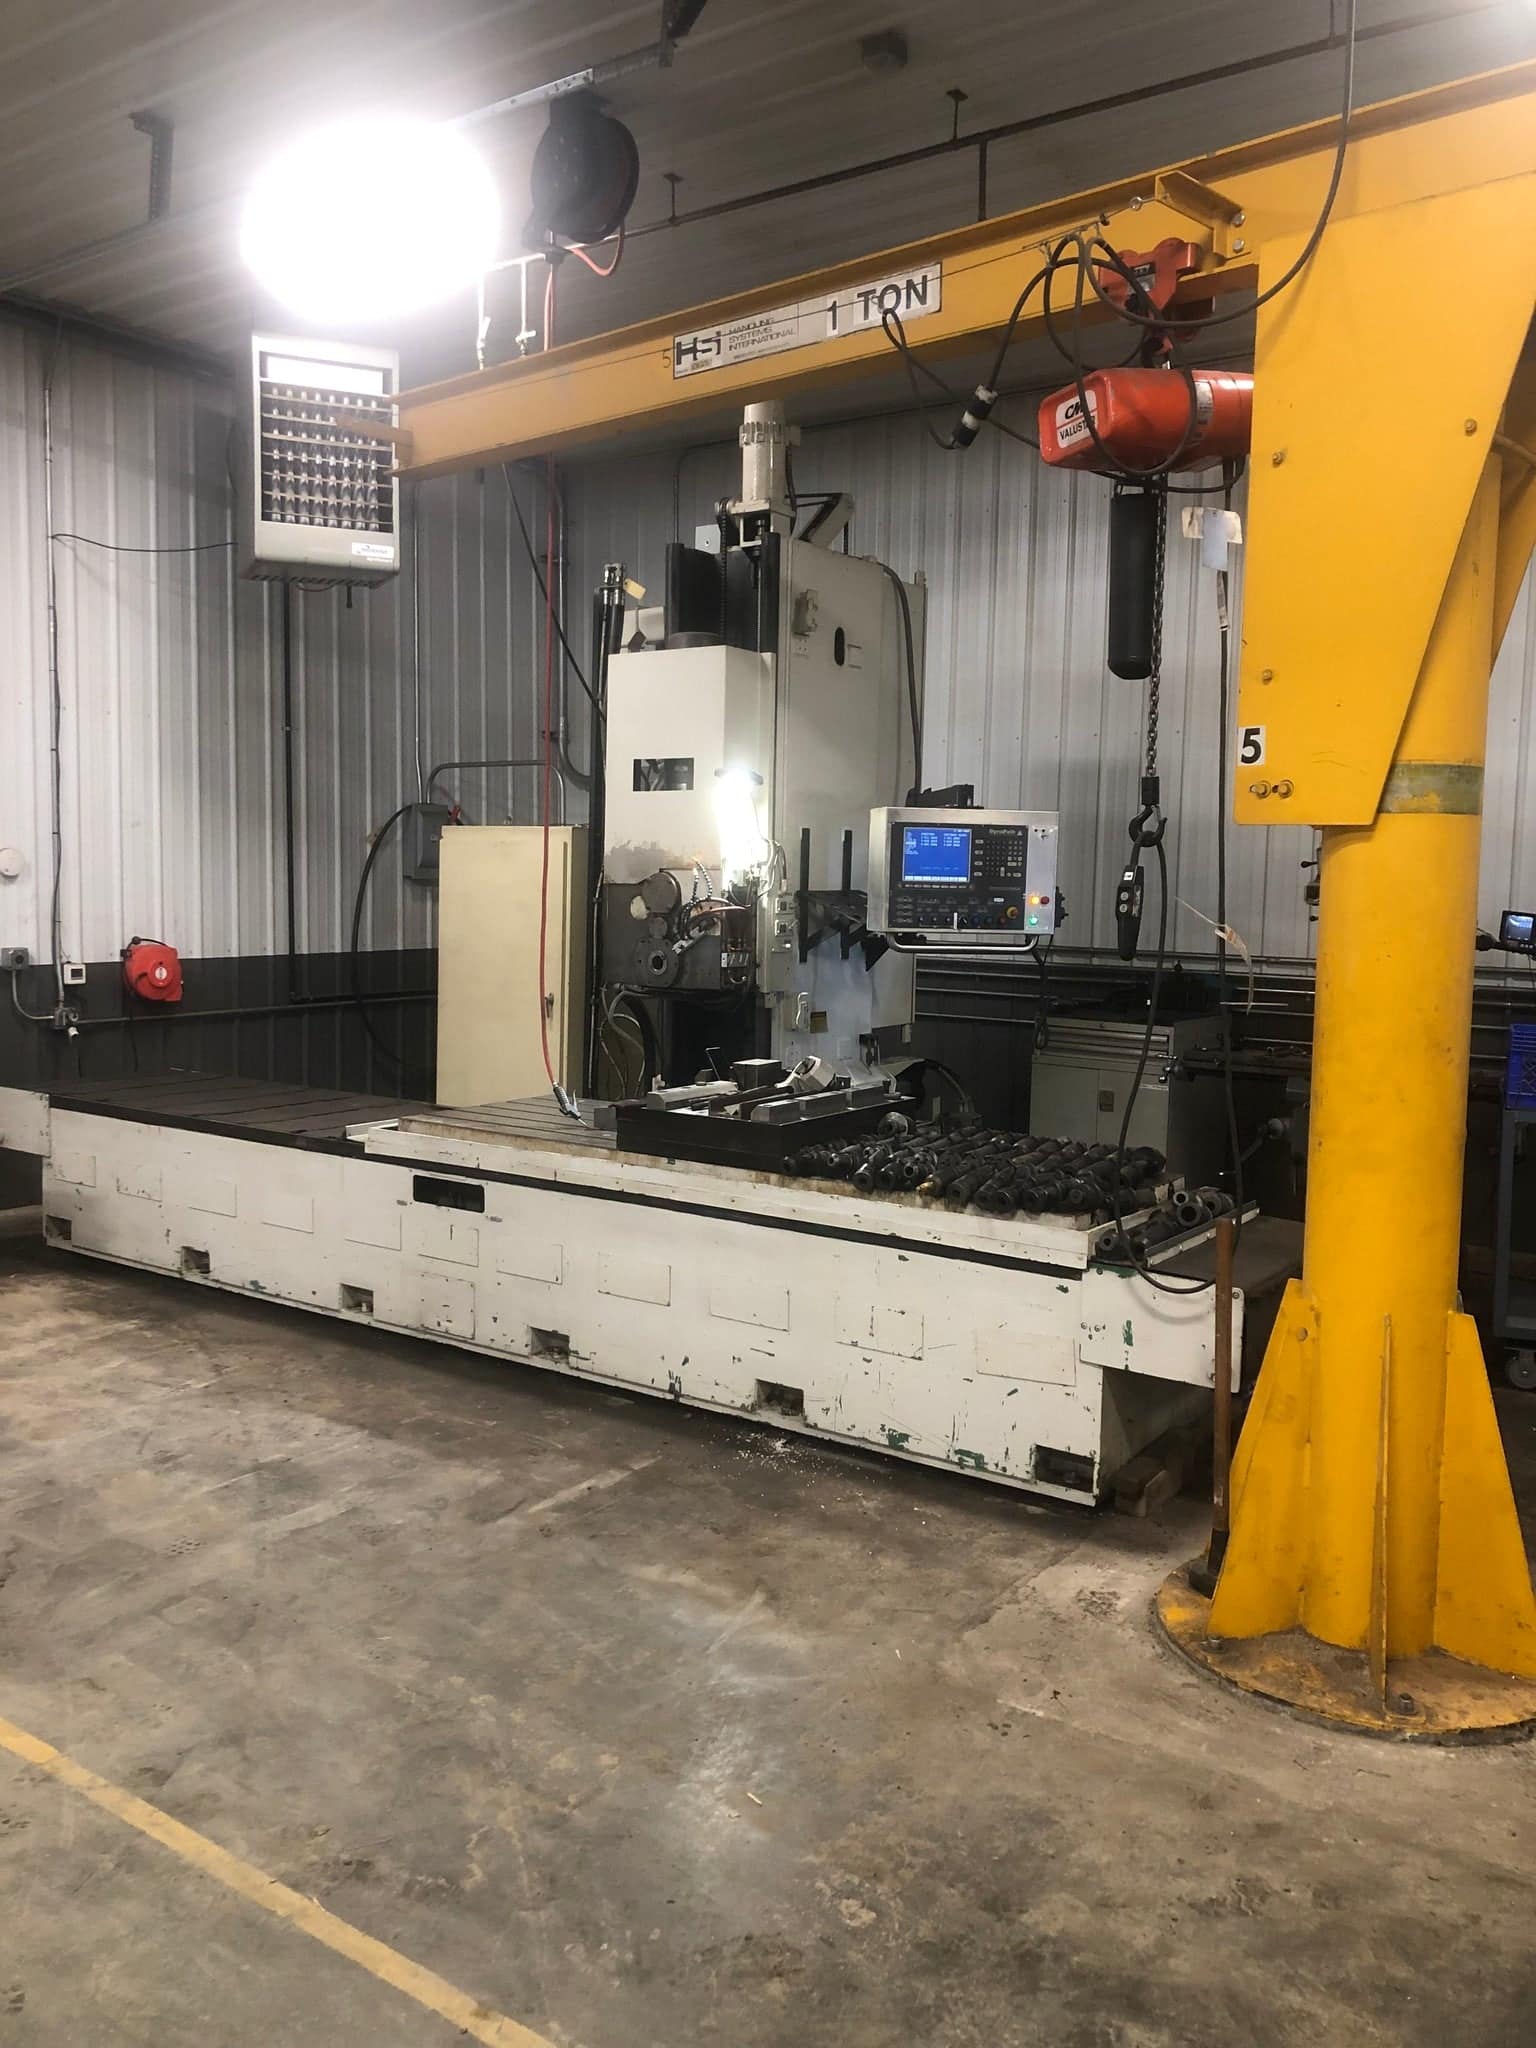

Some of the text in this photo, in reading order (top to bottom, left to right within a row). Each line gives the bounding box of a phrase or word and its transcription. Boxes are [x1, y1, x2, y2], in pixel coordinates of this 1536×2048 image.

[827, 275, 928, 330] 1 TON
[728, 325, 773, 344] SYSTEMS
[728, 327, 796, 352] INTERNATIONAL
[1060, 416, 1096, 440] VALUST
[1241, 727, 1262, 764] 5
